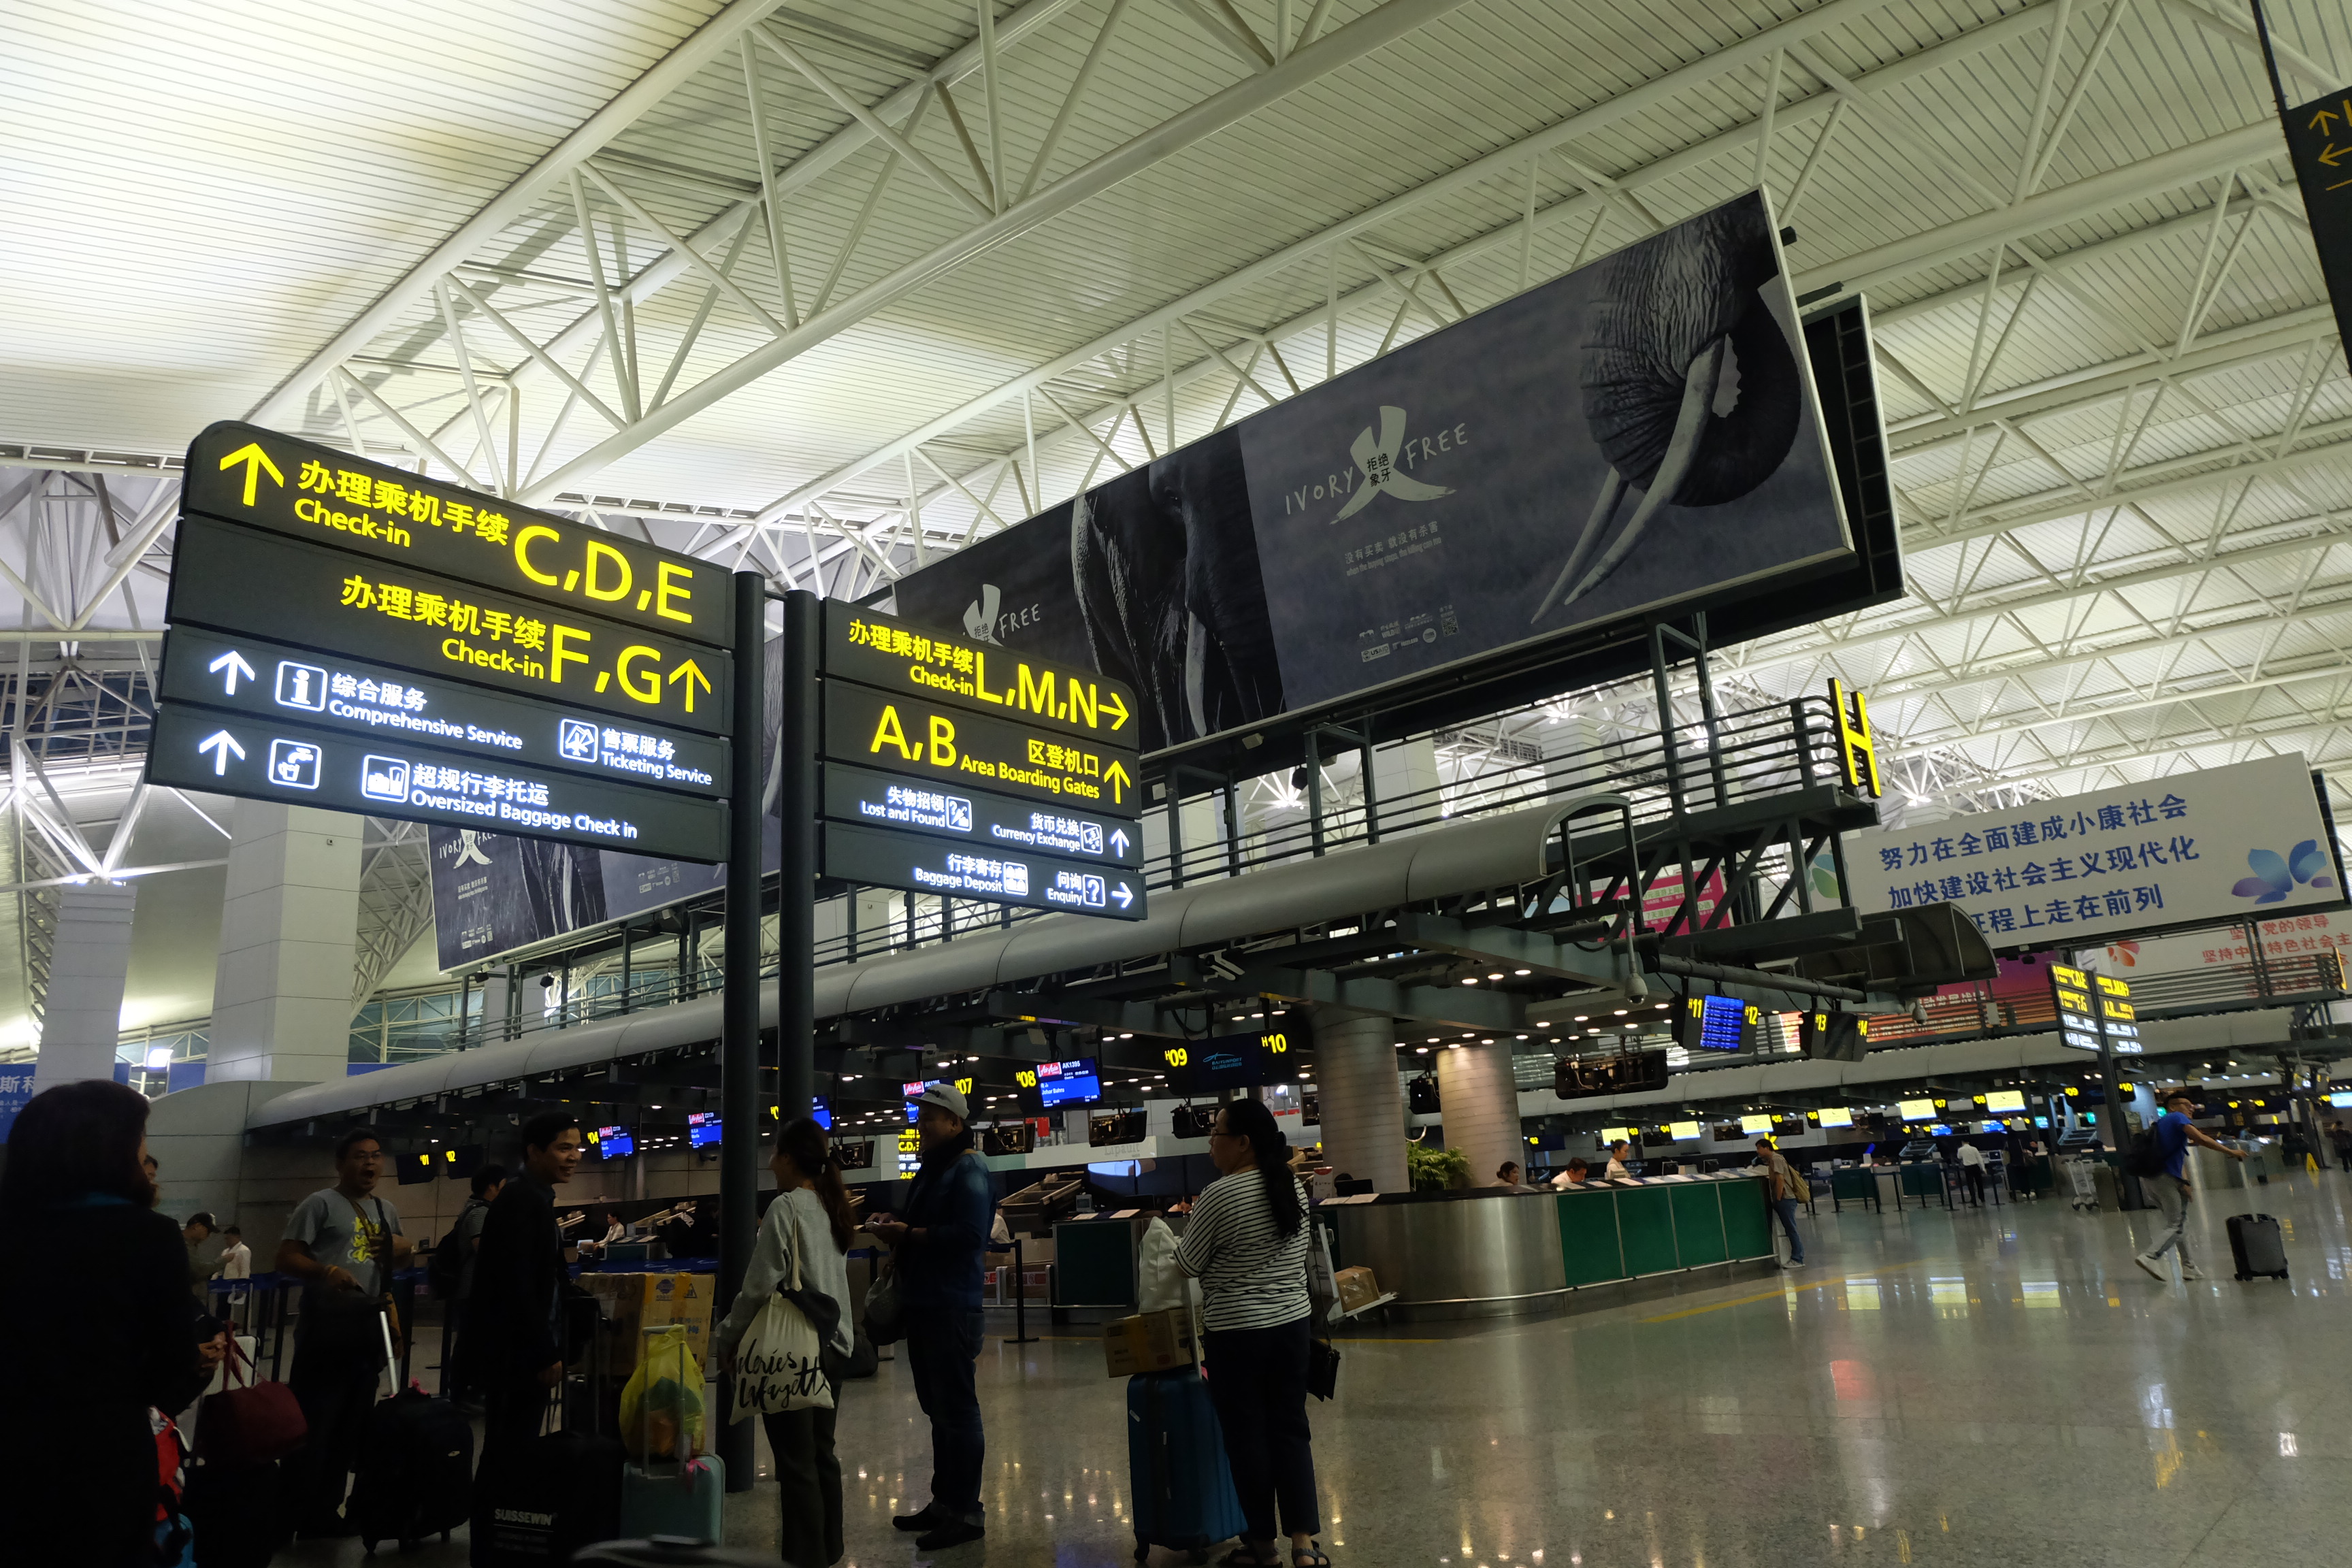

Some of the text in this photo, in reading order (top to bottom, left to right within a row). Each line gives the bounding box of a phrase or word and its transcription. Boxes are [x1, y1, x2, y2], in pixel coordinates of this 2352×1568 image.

[1366, 452, 1390, 472] 拒绝
[1404, 422, 1469, 470] FREE
[1285, 466, 1354, 515] IVORY
[1369, 467, 1392, 488] 象牙
[297, 459, 510, 545] 办理乘机手续
[293, 498, 412, 549] Check-in
[514, 524, 695, 624] C,D,E
[340, 574, 547, 653] 办理乘机手续
[999, 603, 1041, 639] FREE
[441, 637, 545, 681] Check-in
[849, 618, 973, 674] 办理乘机手续
[1371, 646, 1388, 656] USAID
[551, 623, 662, 705] F,G
[909, 665, 975, 697] Check-in
[330, 672, 428, 713] 综合服务
[975, 651, 1098, 729] L,M,N
[328, 700, 524, 751] Comprehensive Service
[870, 704, 957, 767] A,B
[1834, 678, 1882, 796] H
[601, 728, 677, 762] 售票服务
[1028, 738, 1100, 778] 区登机口
[412, 762, 551, 808] 超规行李托运
[601, 751, 713, 786] Ticketing Service
[960, 753, 1100, 800] Area Boarding Gates
[410, 788, 638, 840] Oversized Baggage Check in
[862, 800, 946, 828] Lost and Found
[887, 785, 946, 813] 失物招领
[992, 823, 1081, 852] Currency Exchange
[1031, 812, 1081, 838] 货币兑换
[1880, 794, 2187, 872] 努力在全面建成小康社会
[440, 837, 462, 859] IVORY
[915, 867, 1003, 894] Baggage Deposit
[948, 853, 1002, 880] 行李寄存
[1057, 870, 1083, 891] 问询
[1887, 834, 2200, 910] 加快建设社会主义现代化
[1047, 886, 1083, 907] Enquiry
[2230, 914, 2329, 941] 坚党的领导
[1688, 998, 1702, 1019] H11
[1744, 1005, 1758, 1025] H12
[1164, 1047, 1188, 1067] H09
[1261, 1033, 1287, 1054] H10
[1016, 1070, 1036, 1088] H08
[1062, 1060, 1081, 1069] AK1395
[955, 1078, 973, 1094] H07
[494, 1508, 553, 1526] SUISSEWIN
